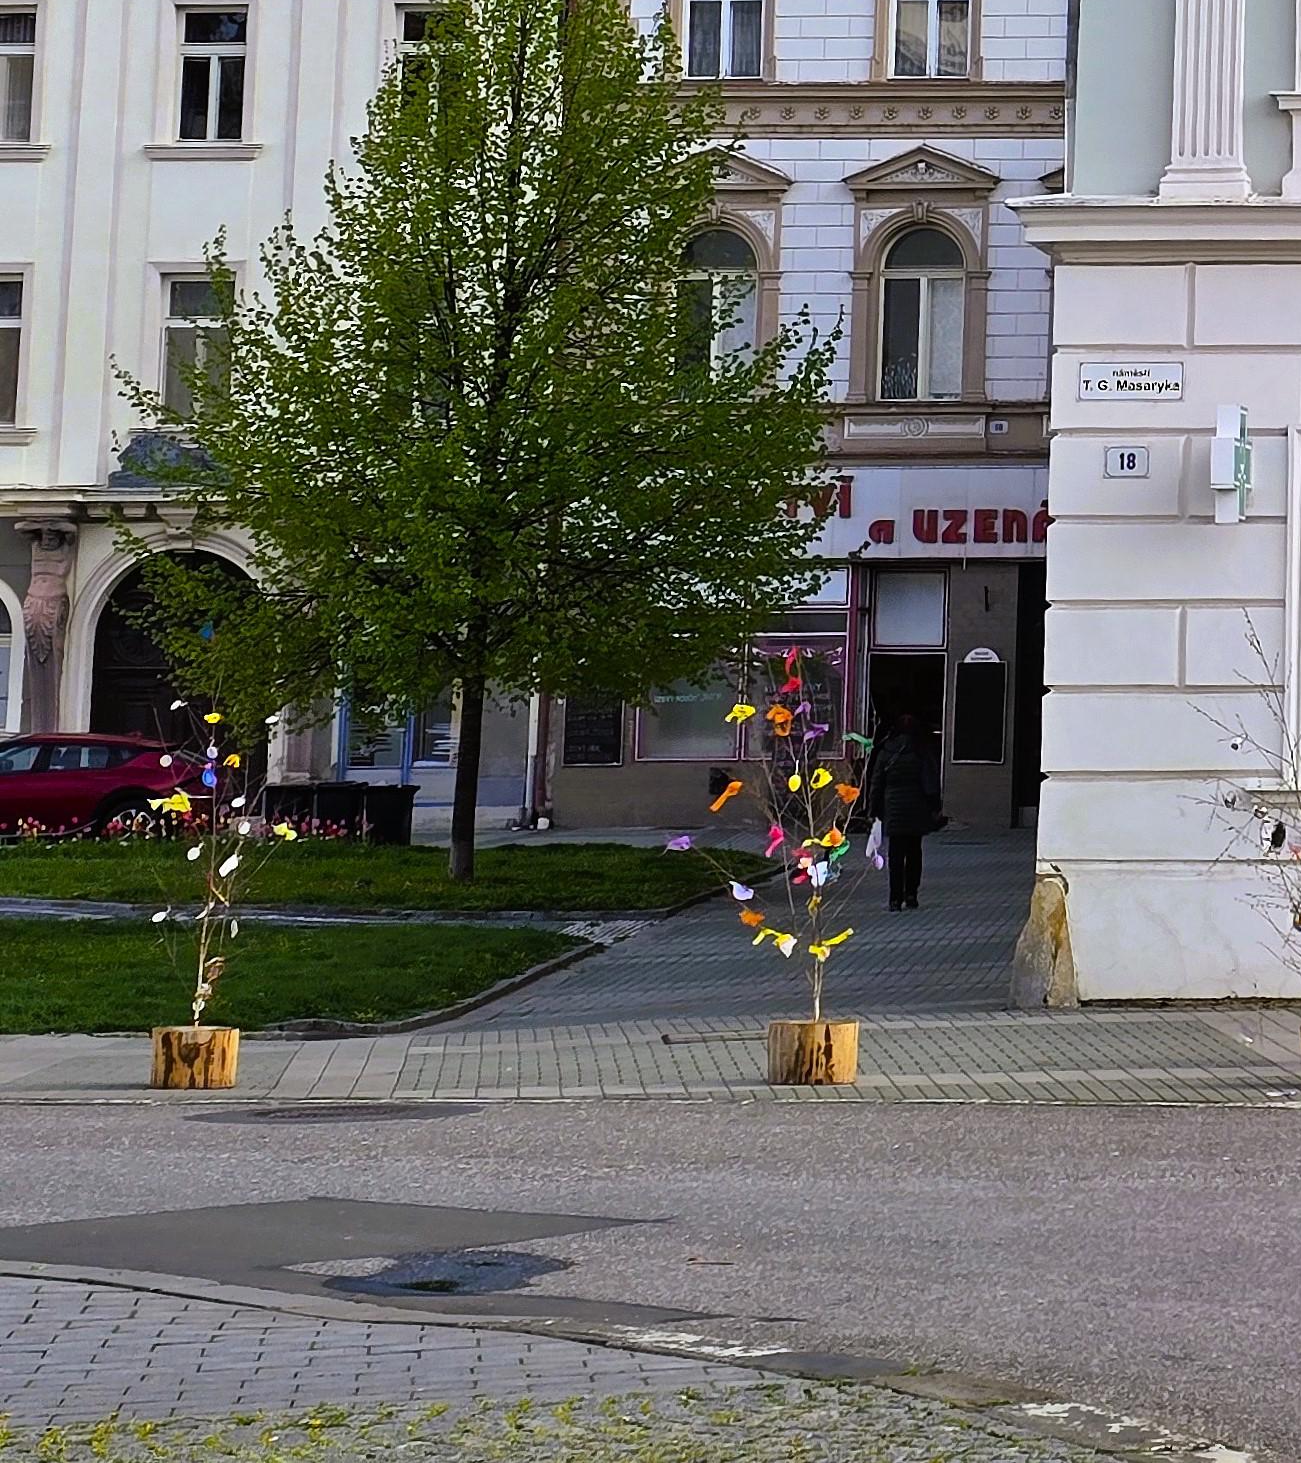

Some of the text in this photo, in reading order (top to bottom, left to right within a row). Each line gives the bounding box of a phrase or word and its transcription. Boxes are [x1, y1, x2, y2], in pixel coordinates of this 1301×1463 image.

[1083, 379, 1180, 394] T. G. Masaryka
[1119, 452, 1137, 471] 18
[868, 520, 896, 545] a
